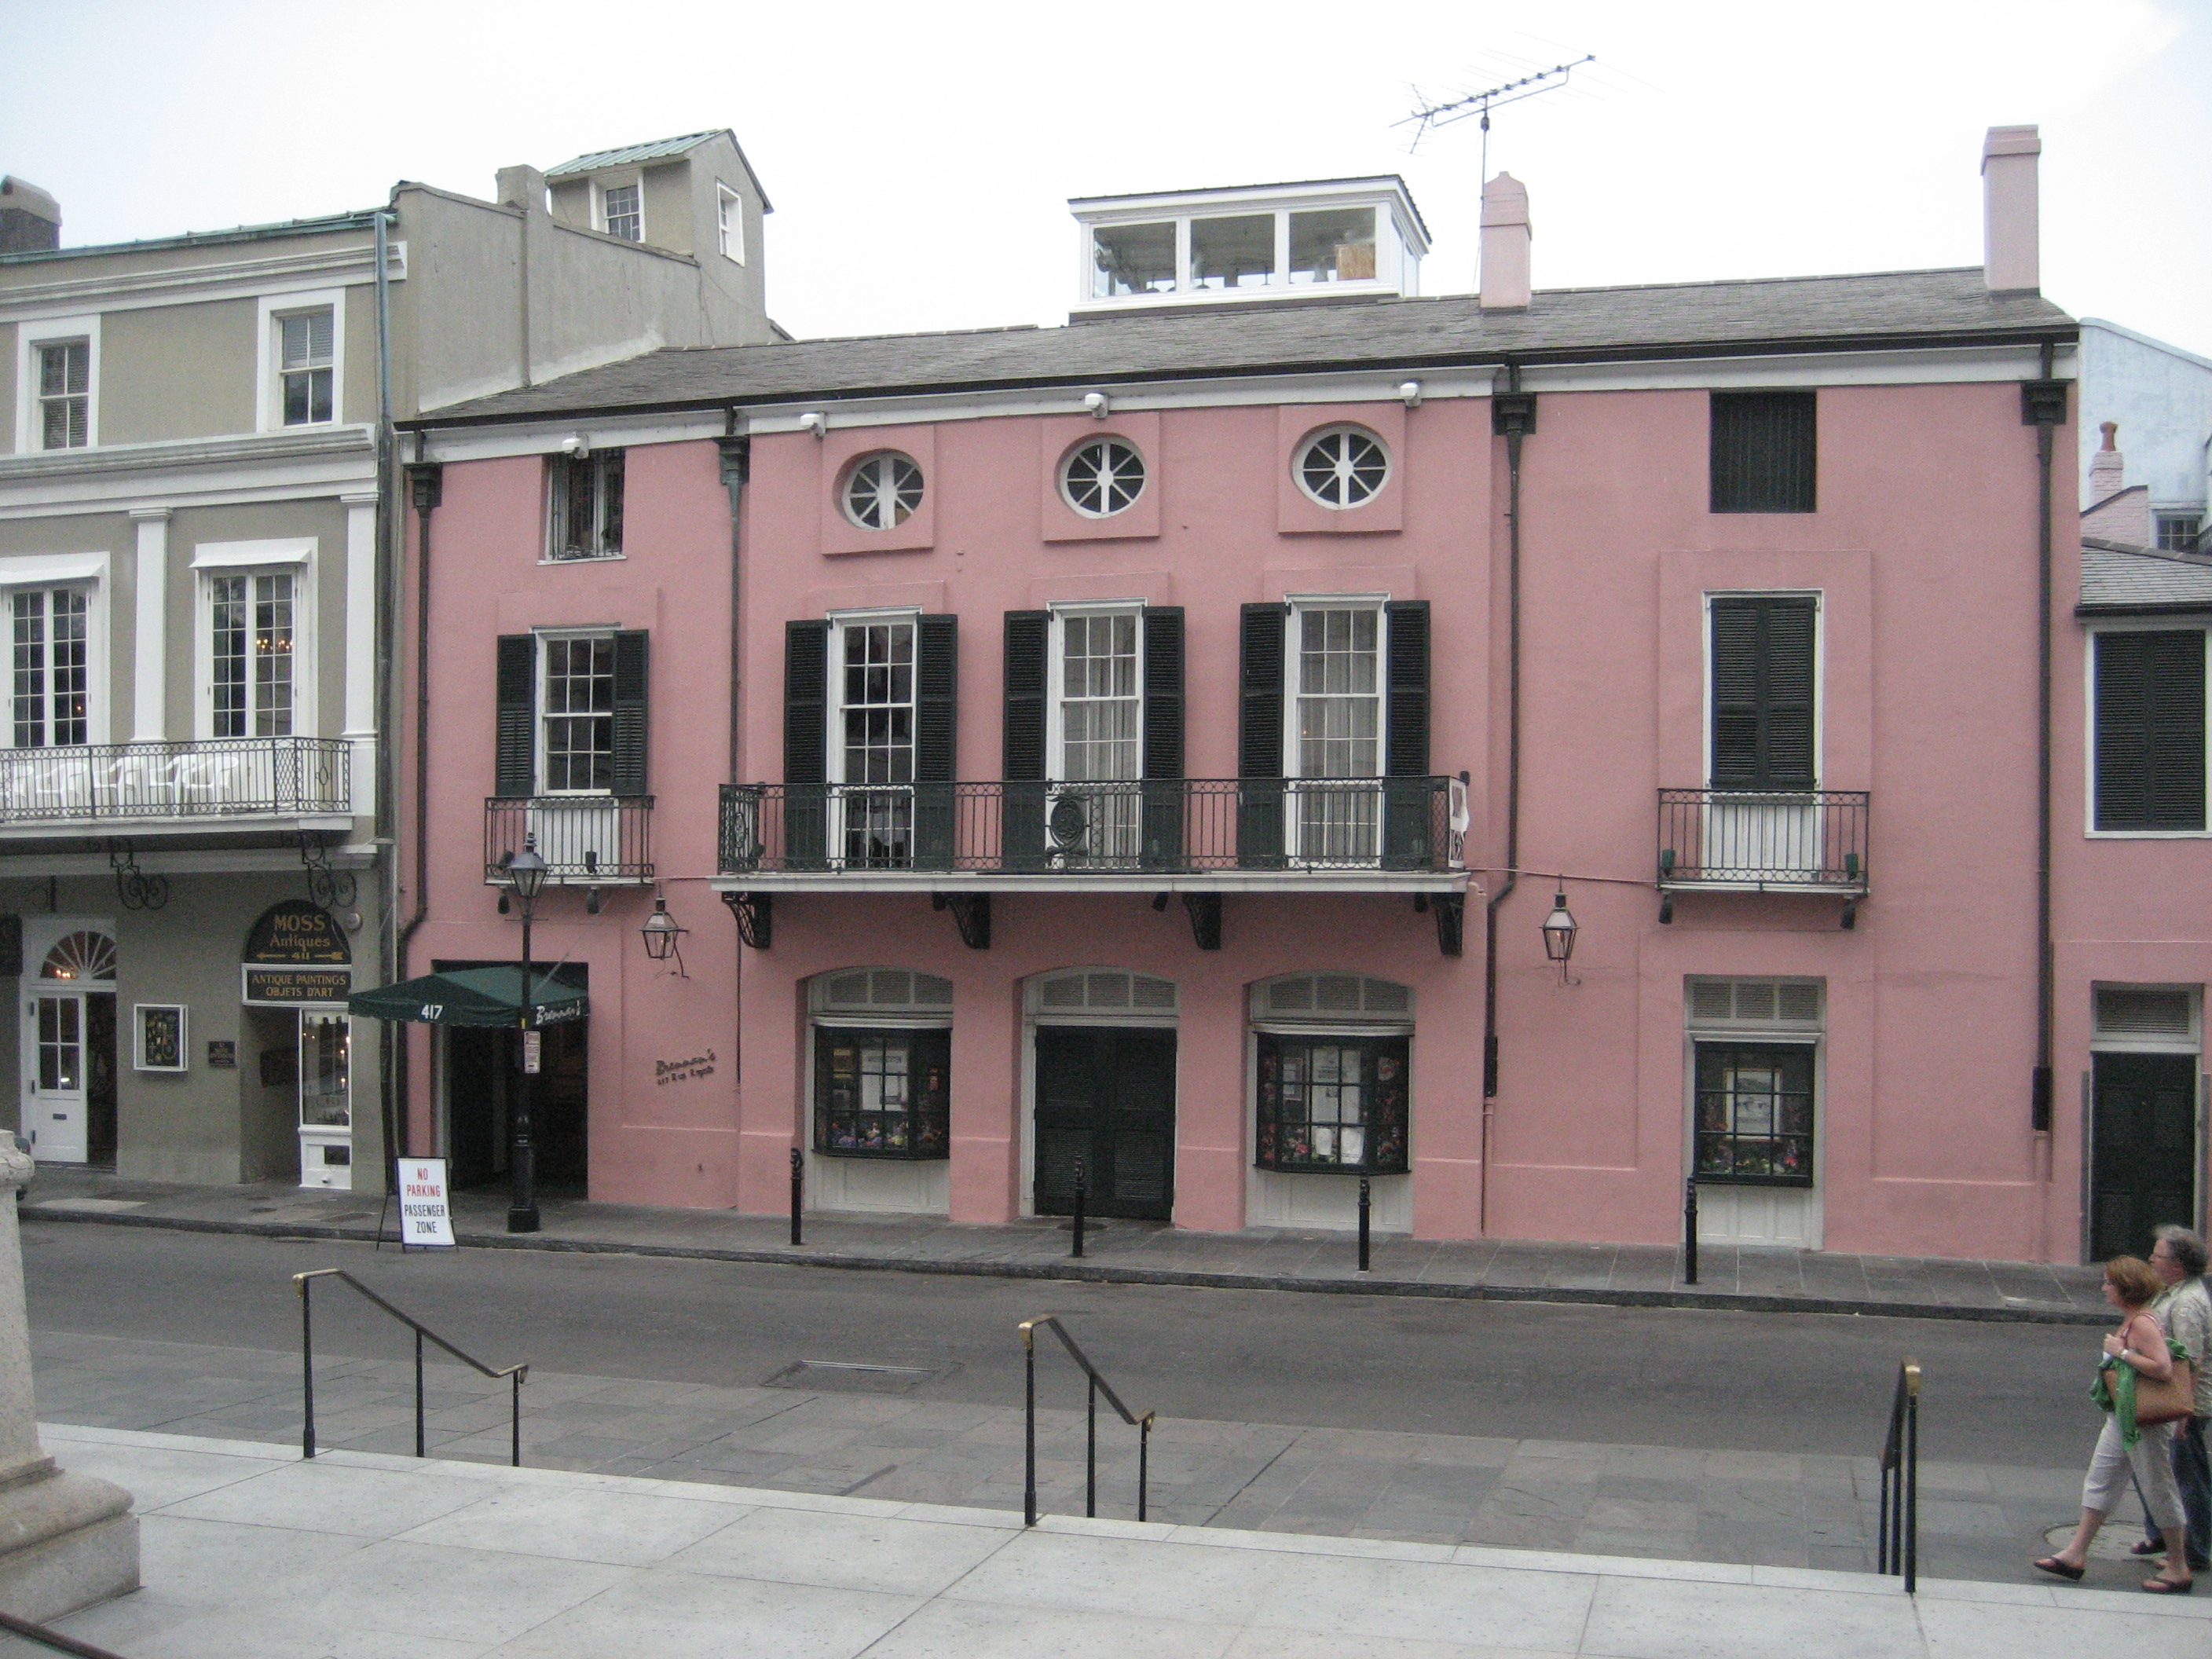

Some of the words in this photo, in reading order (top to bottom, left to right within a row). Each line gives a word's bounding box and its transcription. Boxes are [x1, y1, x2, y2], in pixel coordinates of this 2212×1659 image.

[274, 914, 326, 932] MOSS
[269, 933, 331, 952] Antiques
[291, 951, 310, 961] 411
[251, 975, 292, 986] ANTIQUE
[296, 975, 346, 986] PAINTINGS
[266, 987, 302, 997] OBJETS
[307, 987, 333, 998] D'ART
[421, 1004, 443, 1020] 417
[417, 1167, 429, 1180] NO
[406, 1185, 441, 1197] PARKING
[404, 1204, 446, 1218] PASSENGER
[416, 1221, 438, 1234] ZONE
